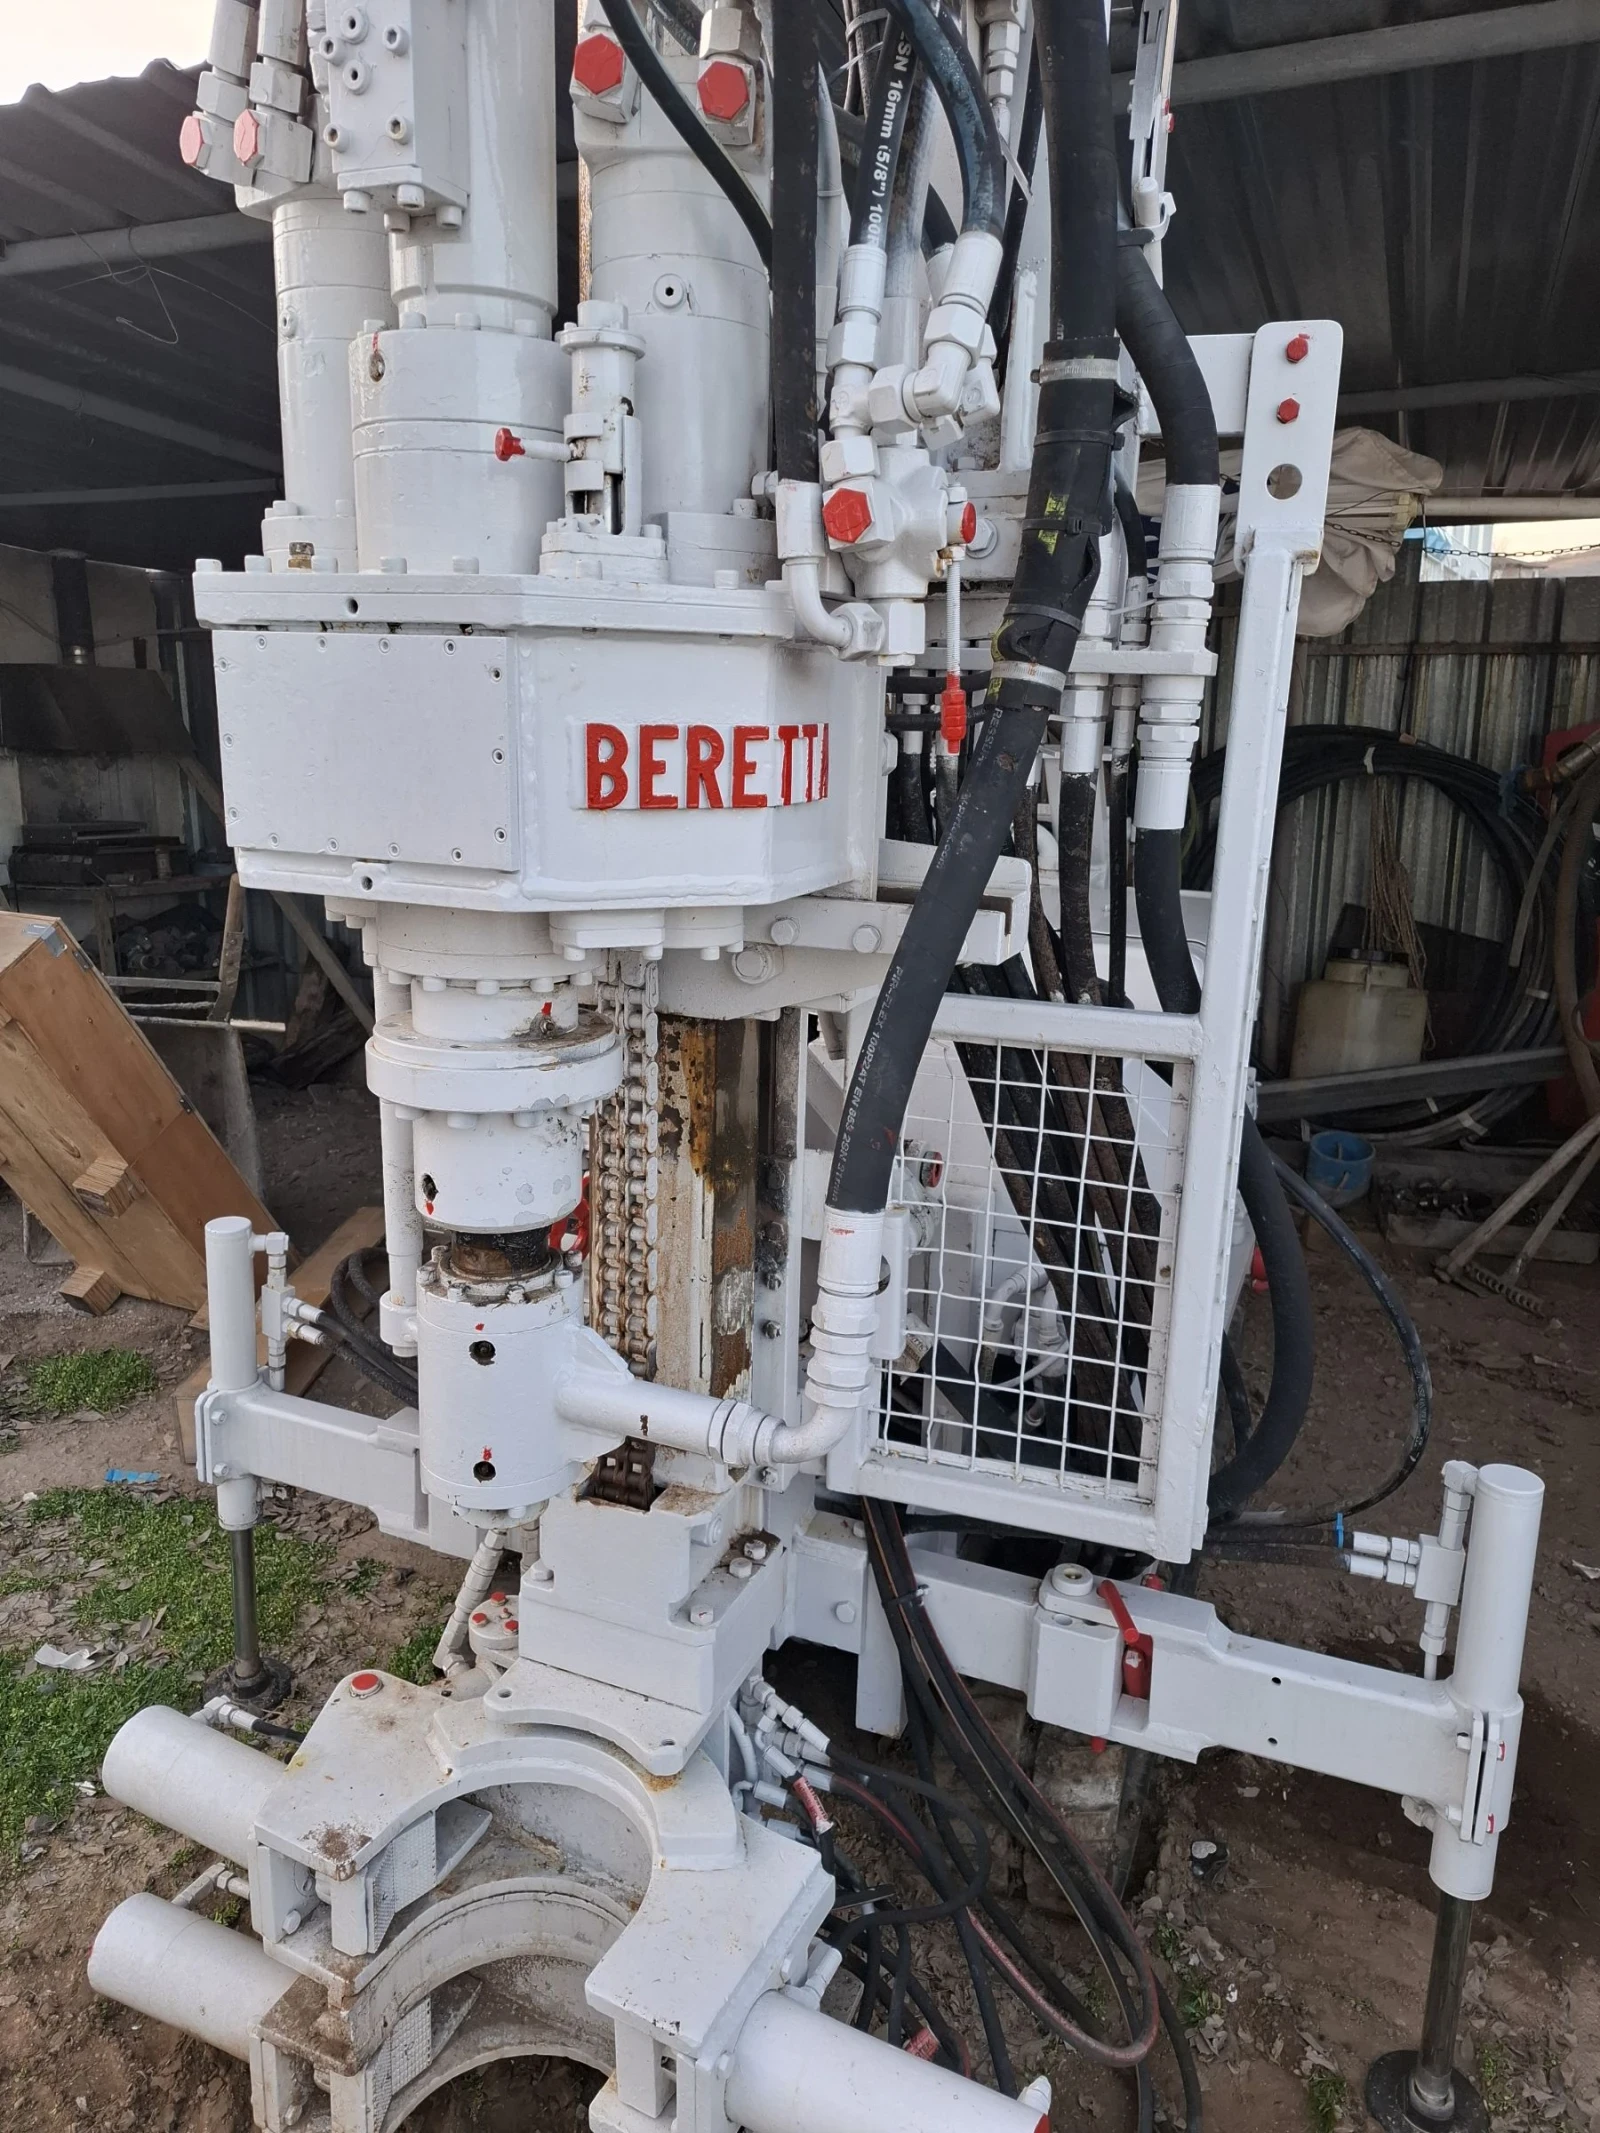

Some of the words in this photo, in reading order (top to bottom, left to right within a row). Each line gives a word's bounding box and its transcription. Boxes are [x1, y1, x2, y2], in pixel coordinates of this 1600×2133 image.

[880, 80, 904, 138] 16mm
[871, 145, 892, 197] (5/8")
[851, 1086, 863, 1108] EN
